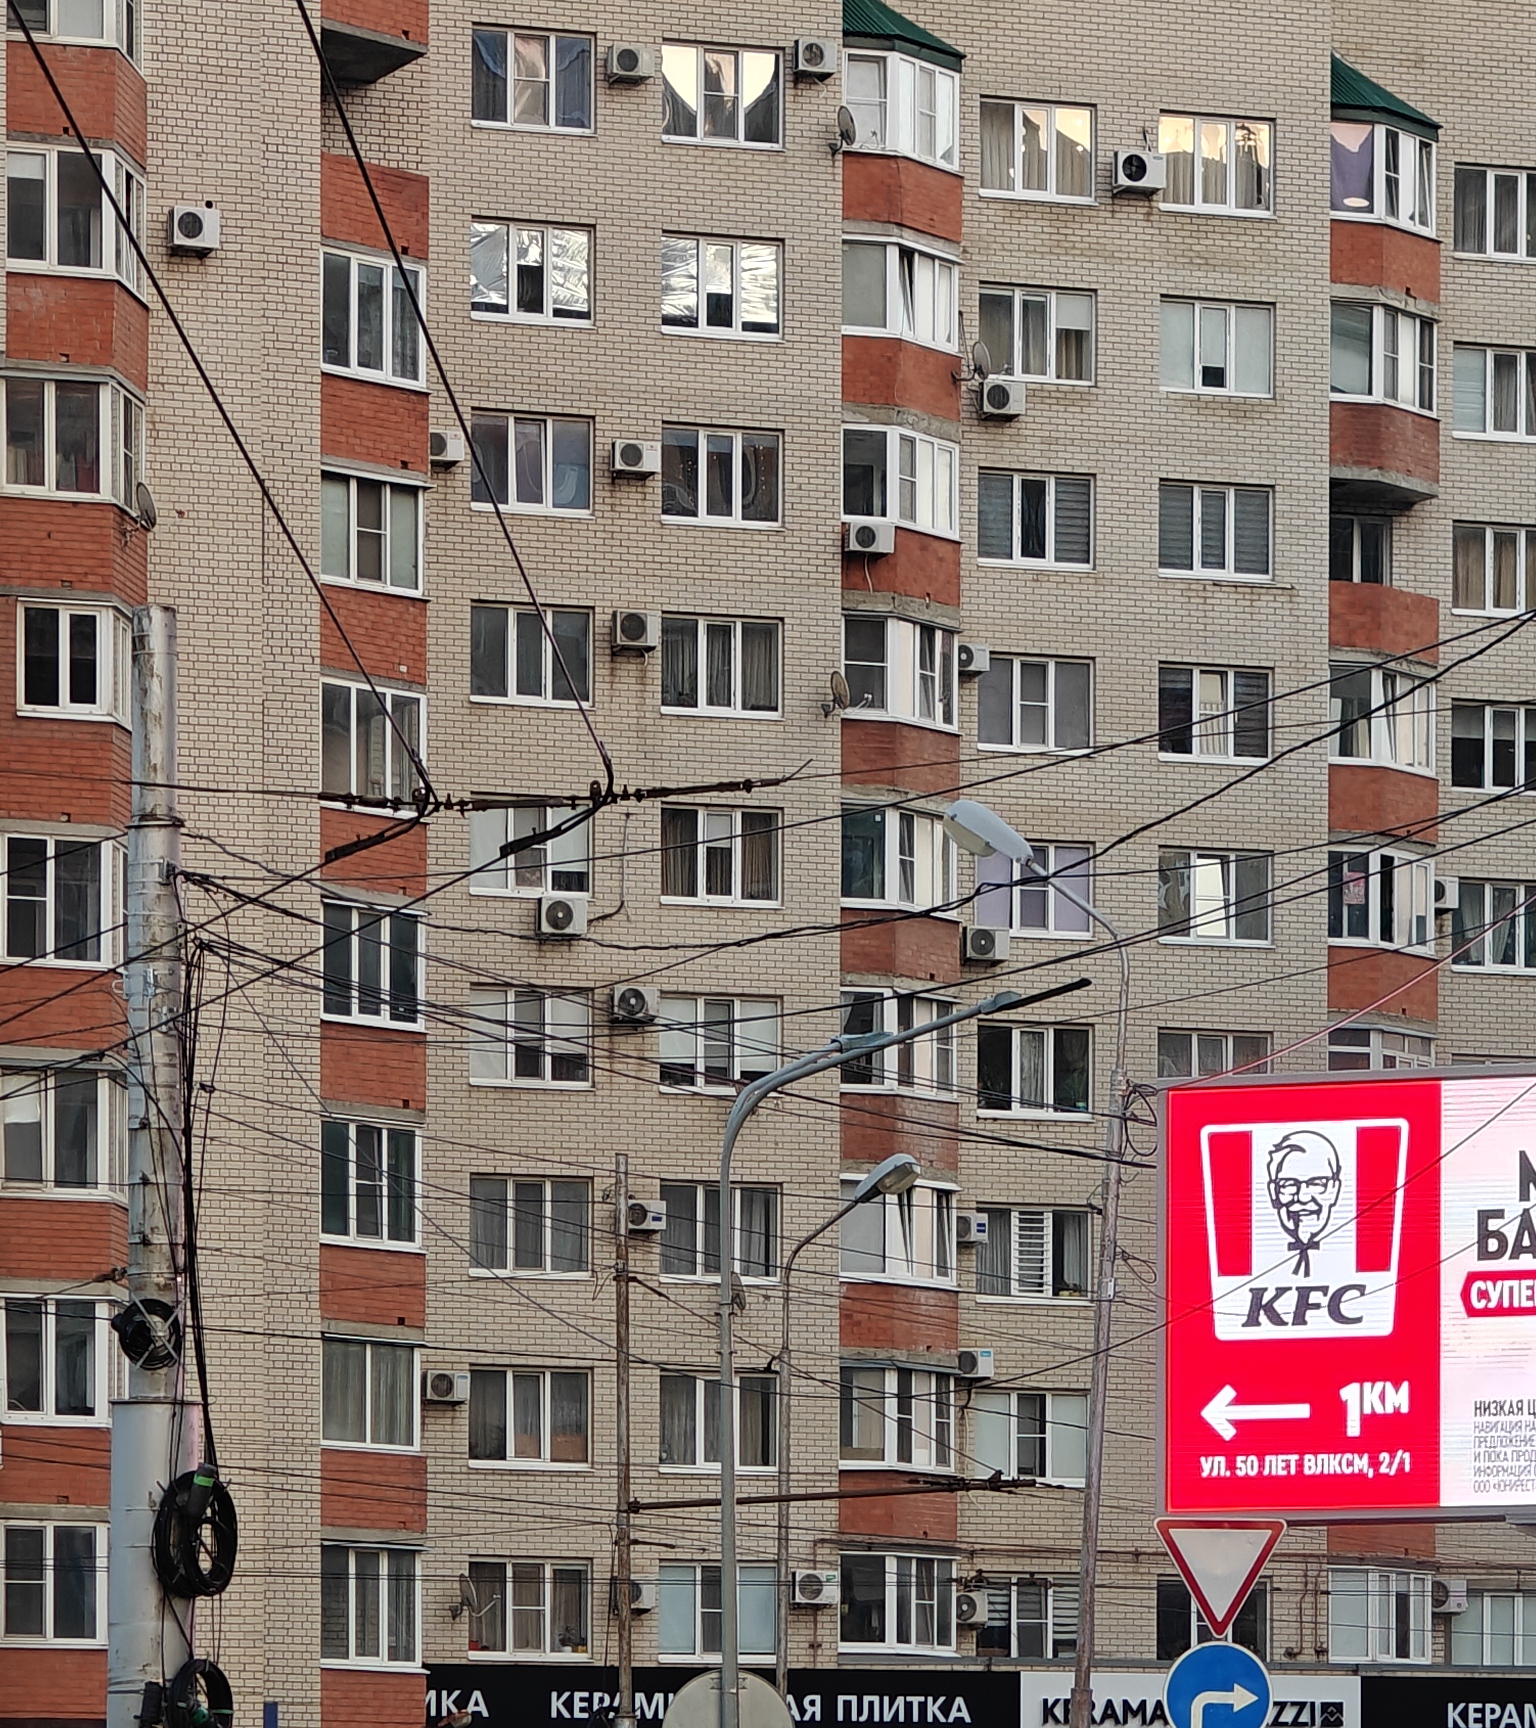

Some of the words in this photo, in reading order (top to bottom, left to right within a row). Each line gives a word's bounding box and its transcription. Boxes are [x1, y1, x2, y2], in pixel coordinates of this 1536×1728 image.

[1241, 1284, 1367, 1328] KFC
[1474, 1399, 1524, 1417] НИЗКАЯ
[1199, 1456, 1231, 1478] УЛ.
[1235, 1455, 1259, 1477] 50
[1263, 1454, 1300, 1476] ЛЕТ
[1304, 1453, 1374, 1478] ВЛКСМ,
[1378, 1449, 1411, 1476] 2/1
[836, 1694, 972, 1723] ПЛИТКА
